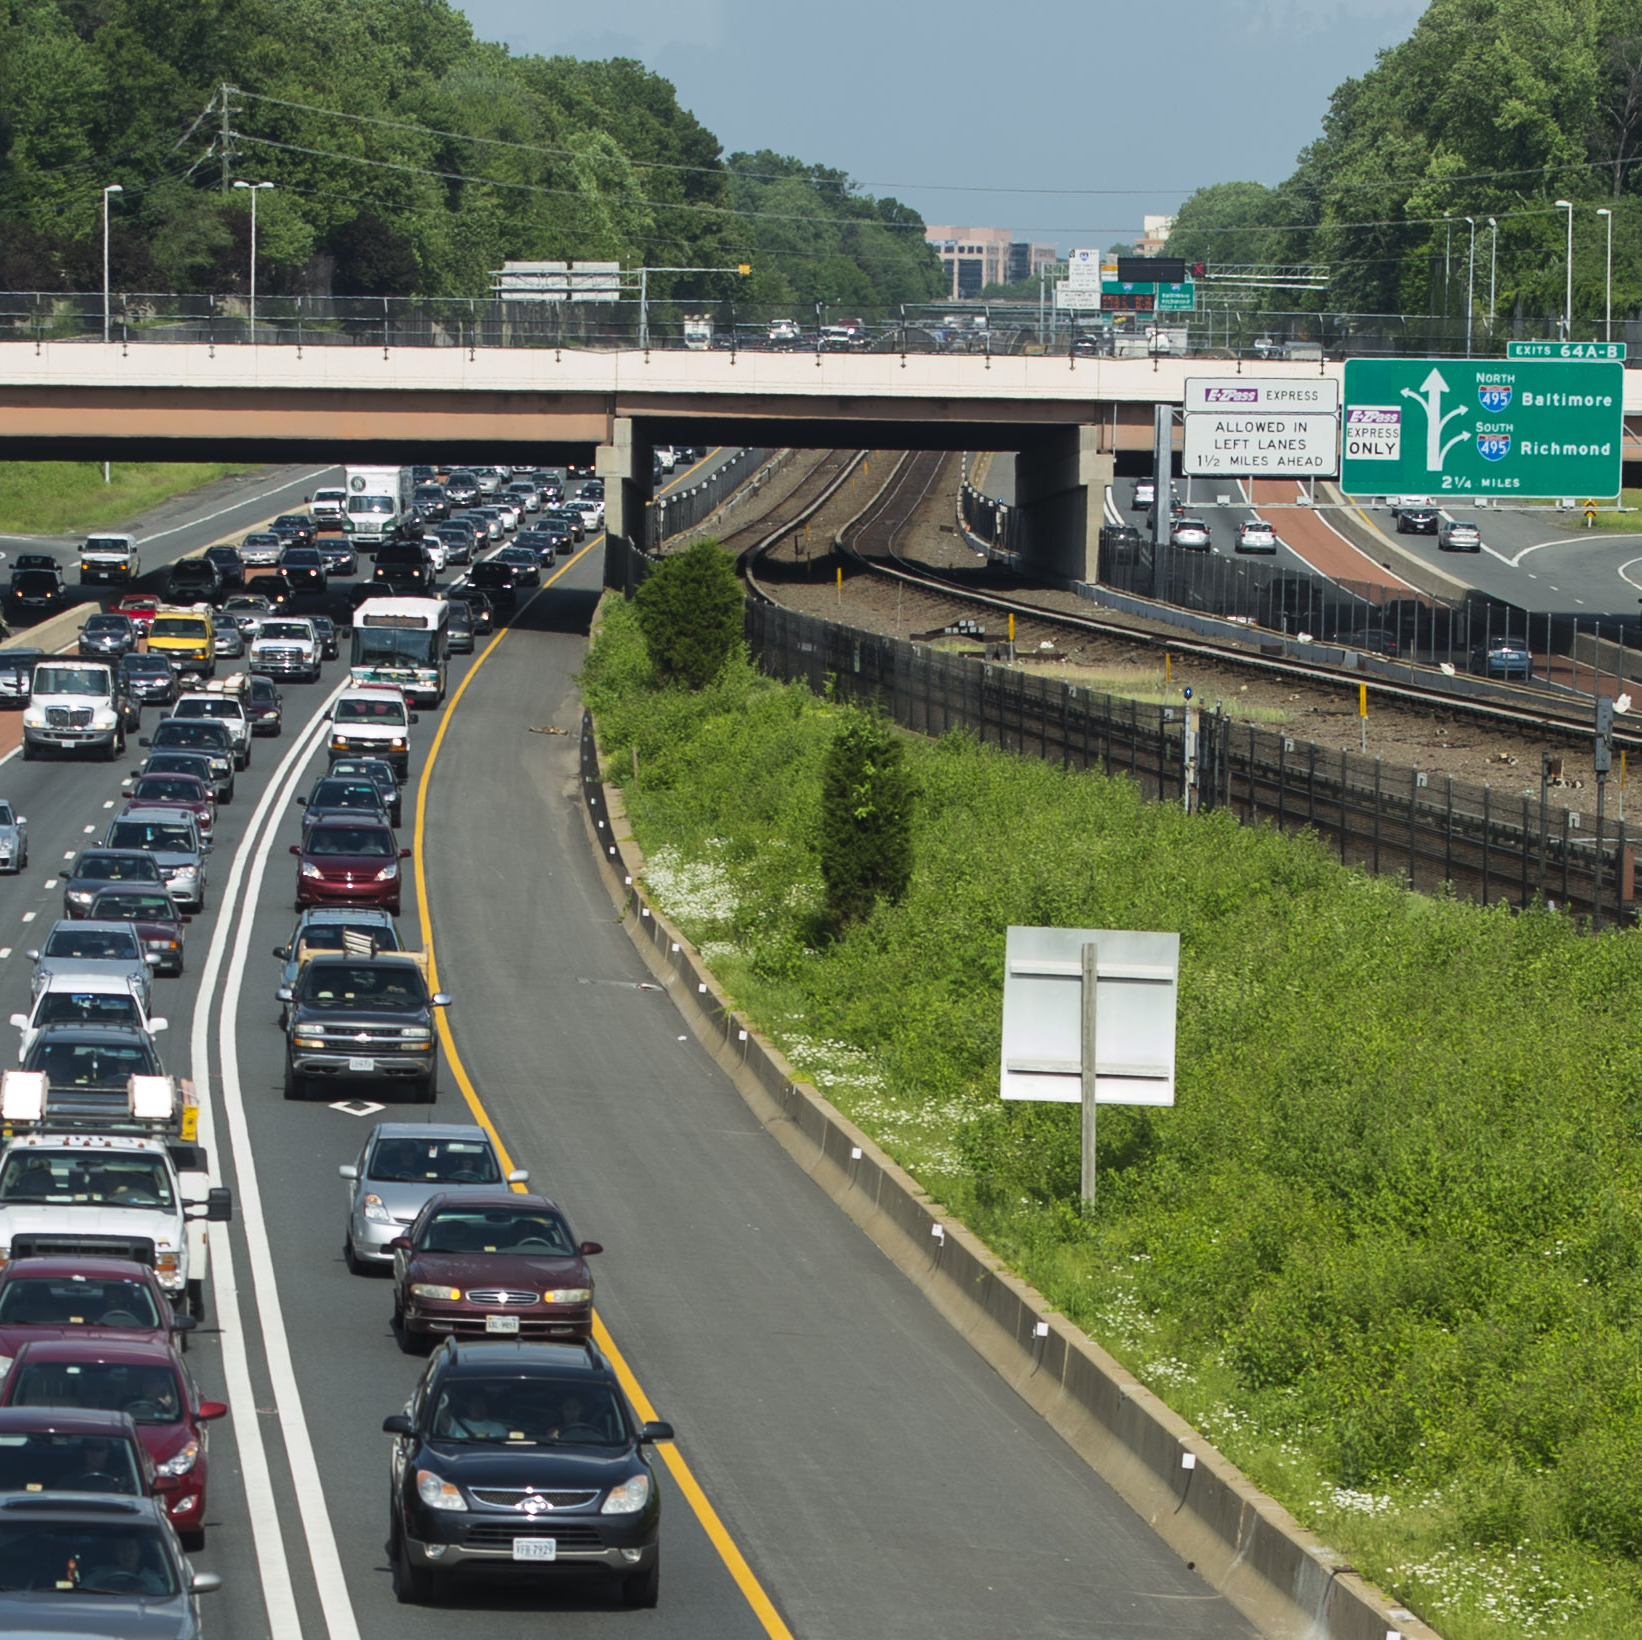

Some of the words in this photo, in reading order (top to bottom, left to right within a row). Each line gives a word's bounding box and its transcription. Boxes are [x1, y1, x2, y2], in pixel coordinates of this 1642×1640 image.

[1515, 345, 1551, 355] EXITS
[1560, 345, 1618, 358] 64A-B
[1476, 373, 1515, 383] NORTH
[1266, 390, 1318, 401] EXPRESS
[1482, 392, 1508, 406] 495
[1522, 392, 1613, 407] Baltimore
[1215, 422, 1285, 433] ALLOWED
[1294, 422, 1307, 433] IN
[1475, 421, 1514, 432] SOUTH
[1347, 427, 1399, 438] EXPRESS
[1214, 439, 1249, 450] LEFT
[1258, 439, 1306, 450] LANES
[1349, 441, 1396, 455] ONLY
[1481, 441, 1507, 455] 495
[1520, 441, 1611, 456] Richmond
[1230, 456, 1269, 466] MILES
[1277, 457, 1323, 467] AHEAD
[1481, 478, 1521, 488] MILES
